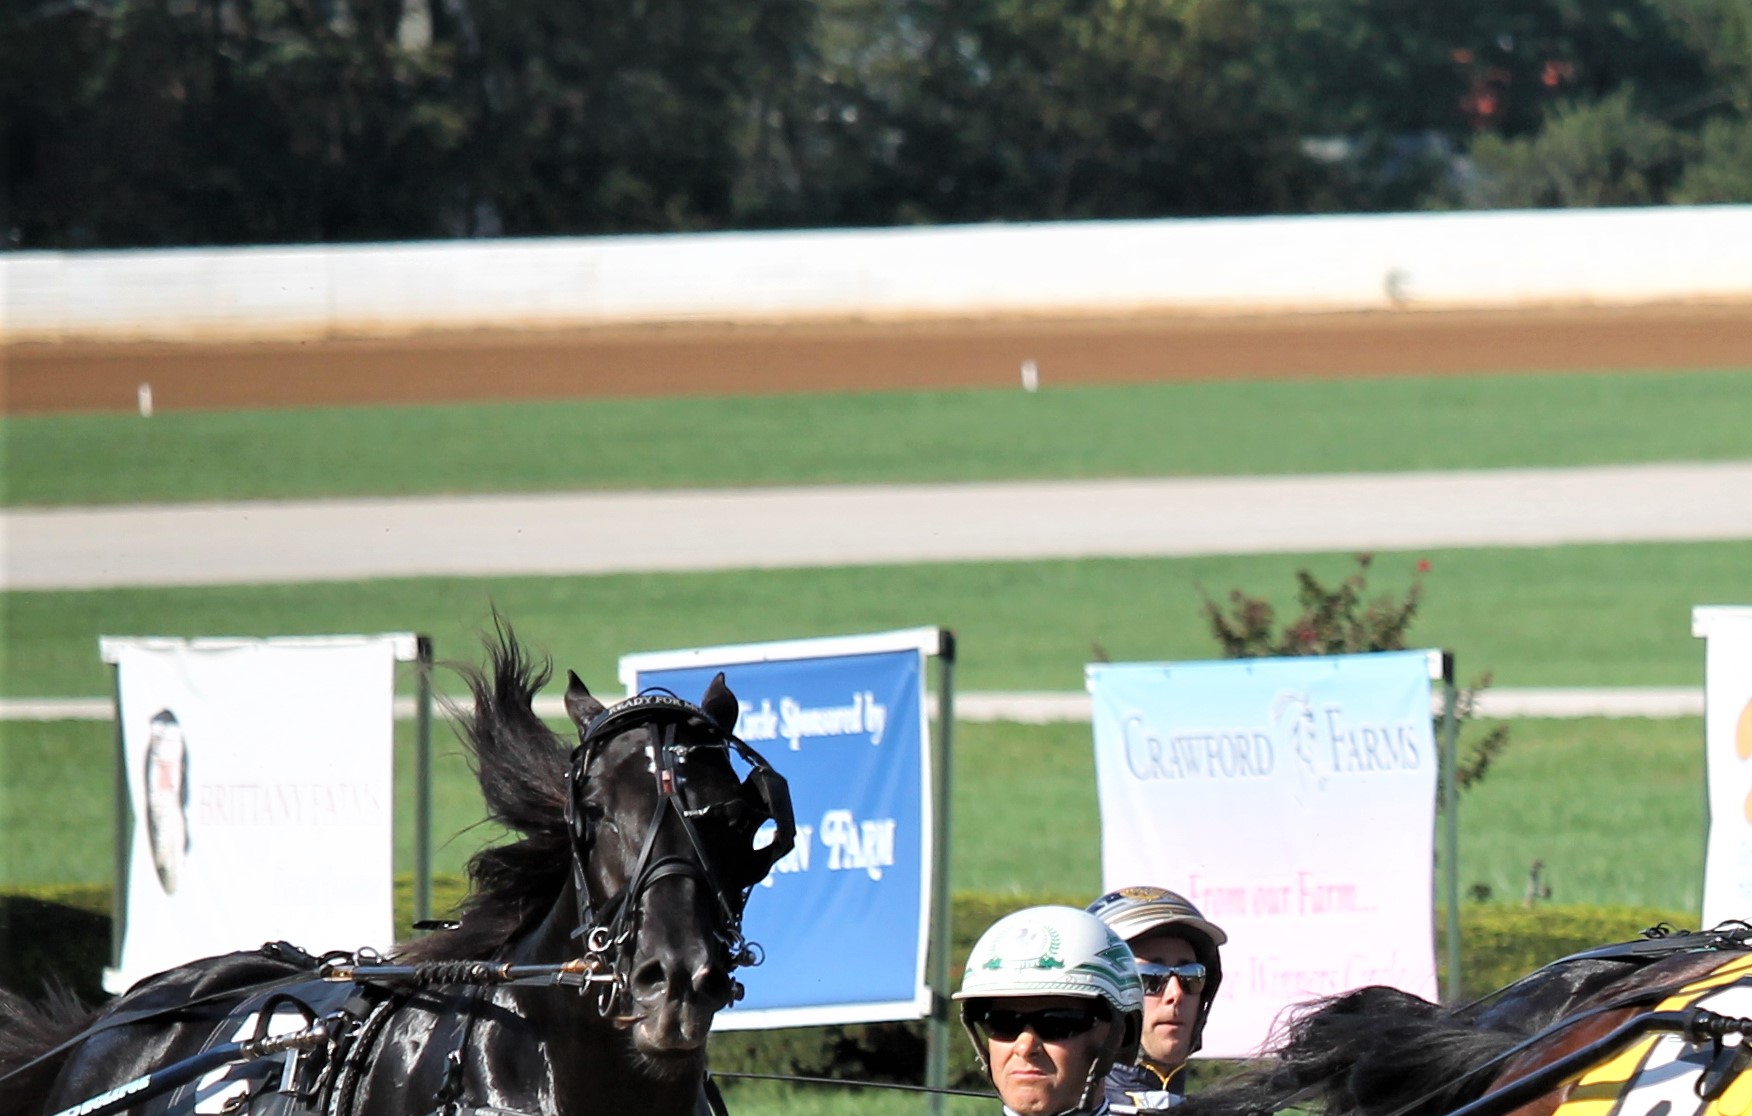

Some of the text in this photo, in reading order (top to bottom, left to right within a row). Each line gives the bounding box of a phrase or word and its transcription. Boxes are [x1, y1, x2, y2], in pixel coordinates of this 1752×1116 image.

[656, 697, 681, 707] FOR
[781, 693, 862, 750] Sponsored
[865, 692, 887, 745] by
[1122, 708, 1421, 780] CRAWFORD FARMS
[199, 783, 307, 826] BRITTANY
[1187, 873, 1247, 917] From
[1253, 885, 1290, 915] our
